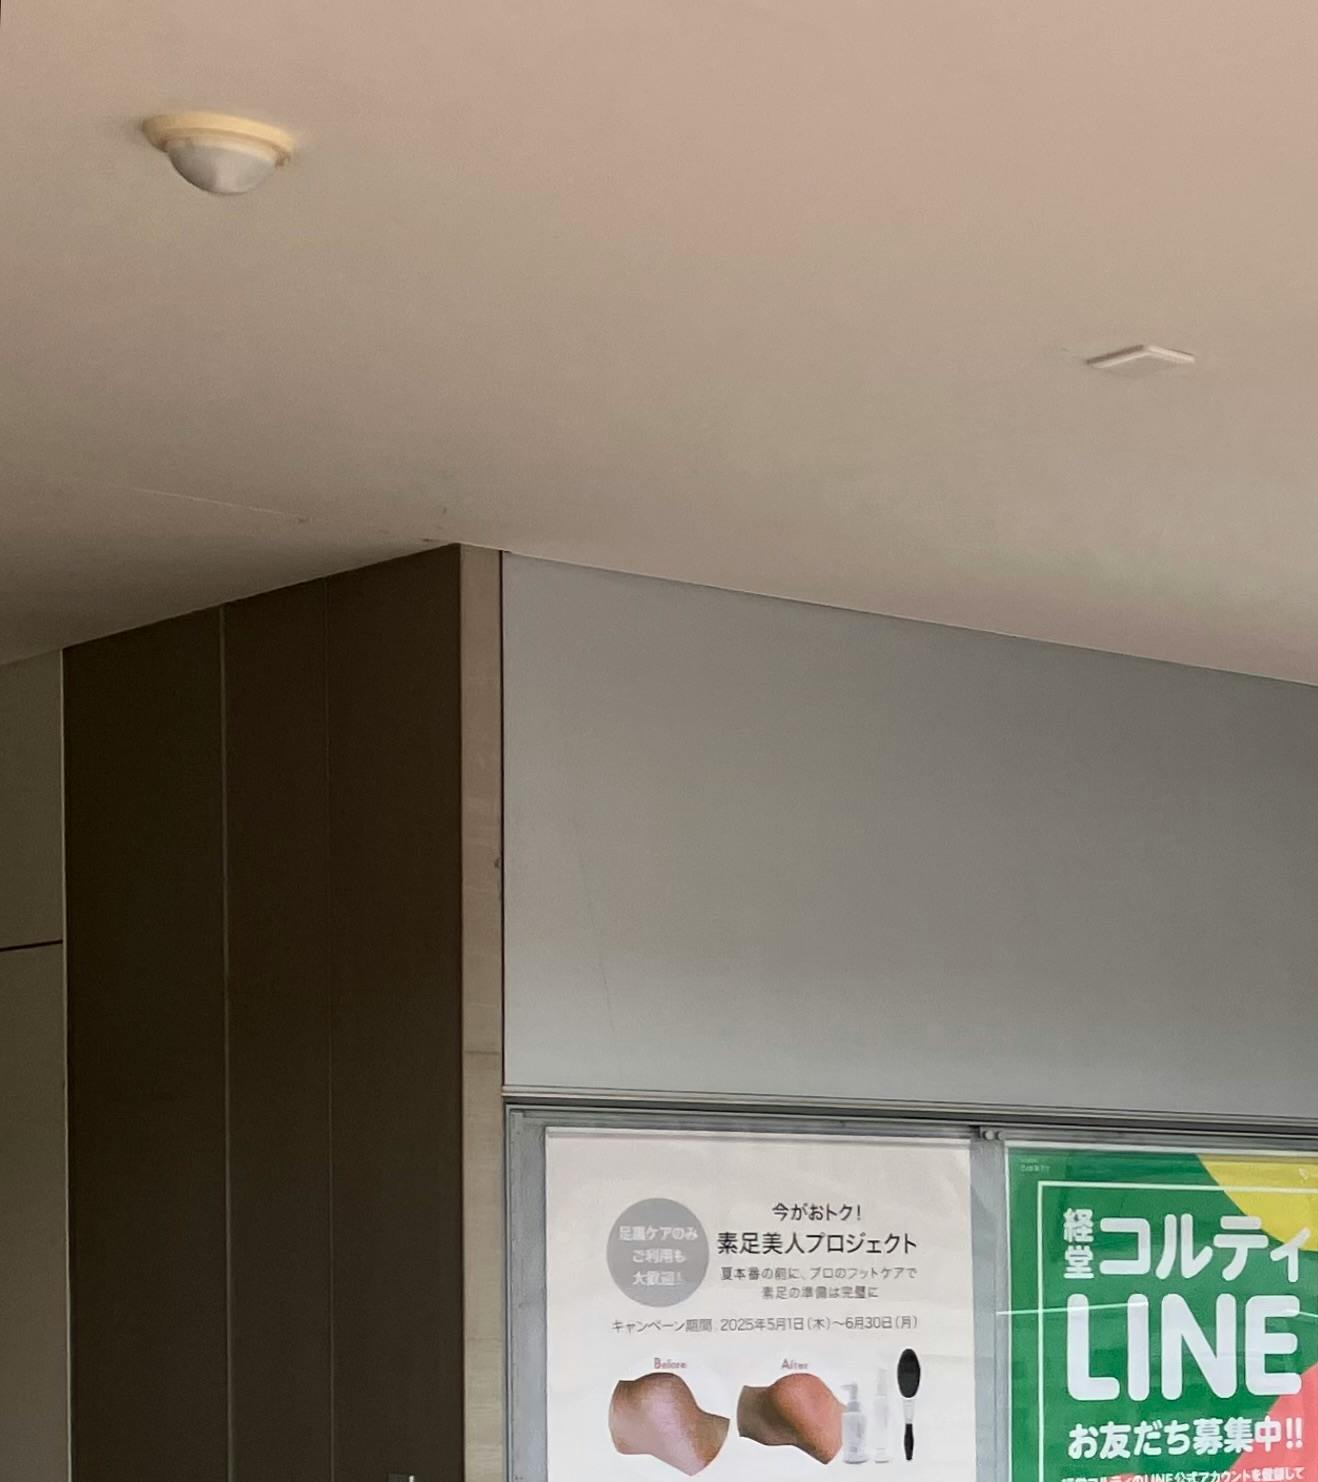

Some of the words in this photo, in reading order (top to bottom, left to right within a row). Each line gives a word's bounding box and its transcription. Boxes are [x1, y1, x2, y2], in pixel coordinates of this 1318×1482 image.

[773, 1203, 862, 1222] 今がおトク！
[717, 1231, 918, 1256] 素足美人プロジェクト
[1062, 1207, 1096, 1280] 経堂
[1099, 1213, 1312, 1283] コルティ
[611, 1318, 713, 1334] キャンペーン期間
[1066, 1293, 1302, 1402] LINE
[653, 1357, 688, 1370] Before
[781, 1358, 809, 1370] After
